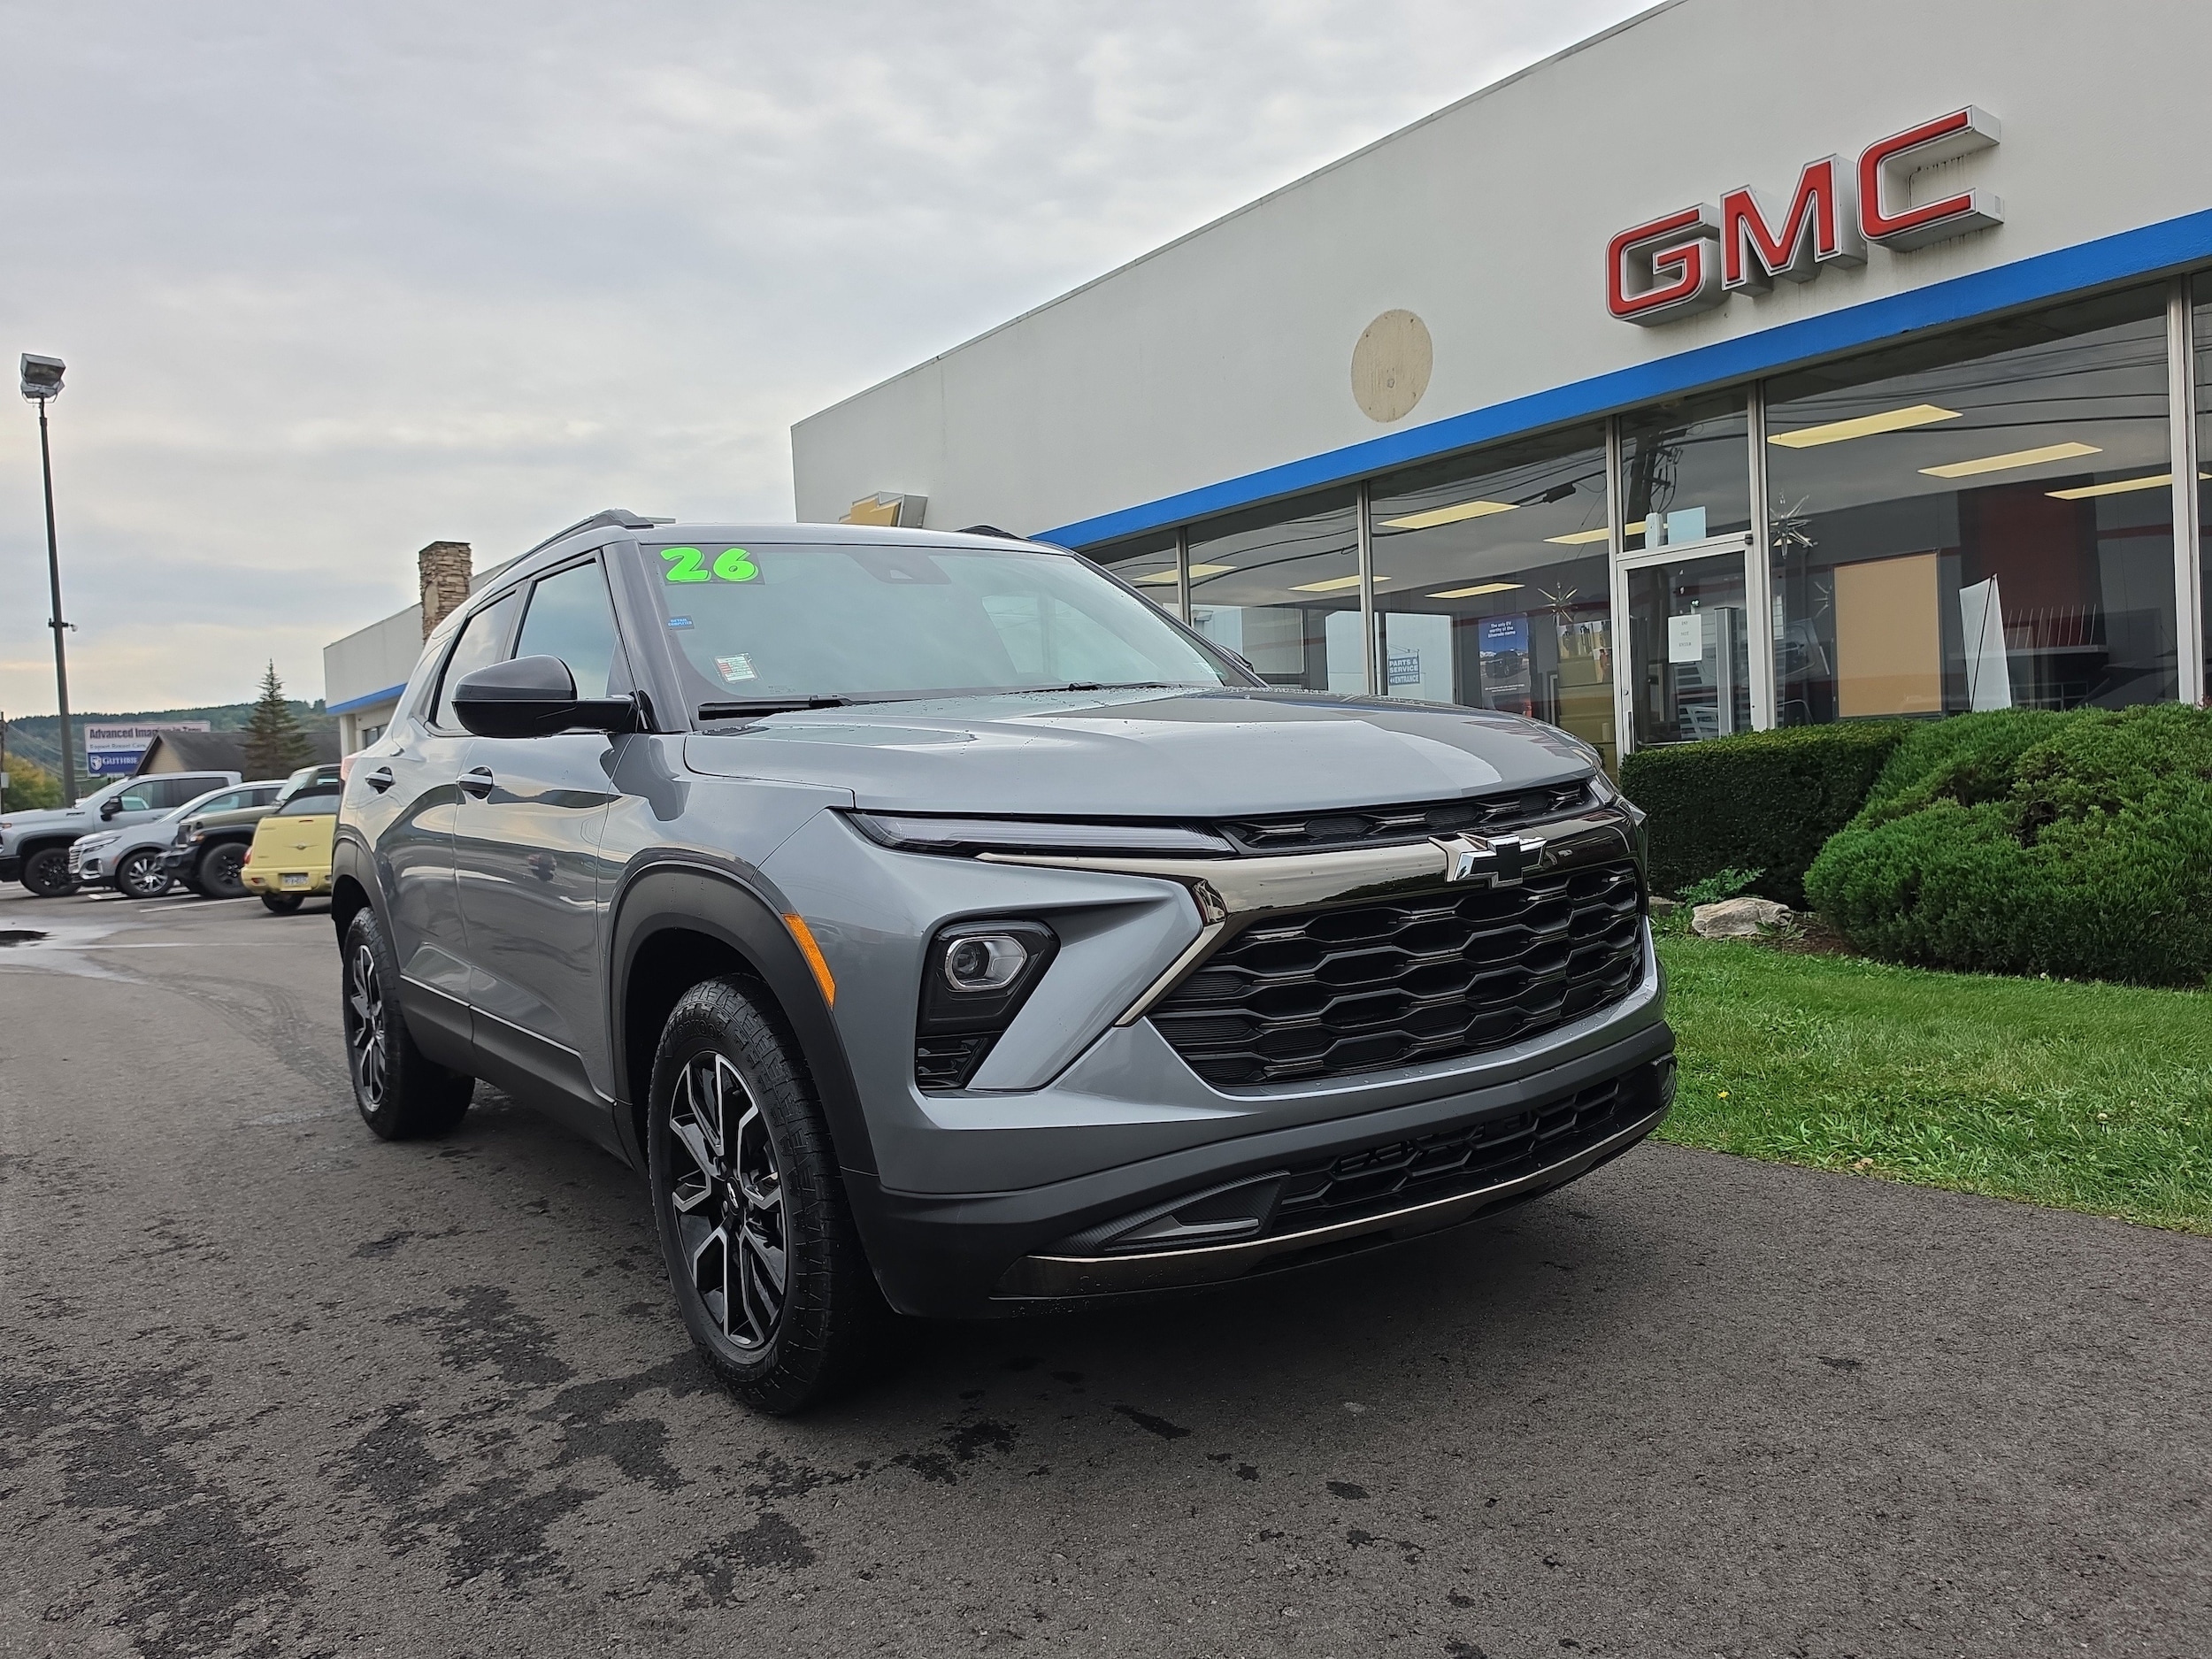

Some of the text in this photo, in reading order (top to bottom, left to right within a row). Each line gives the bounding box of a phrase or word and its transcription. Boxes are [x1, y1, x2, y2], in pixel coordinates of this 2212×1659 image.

[1606, 104, 1986, 322] GMC
[660, 546, 759, 583] 26
[1389, 664, 1418, 673] SERVICE
[1394, 674, 1419, 684] ENTRANCE
[89, 728, 134, 740] Advanced
